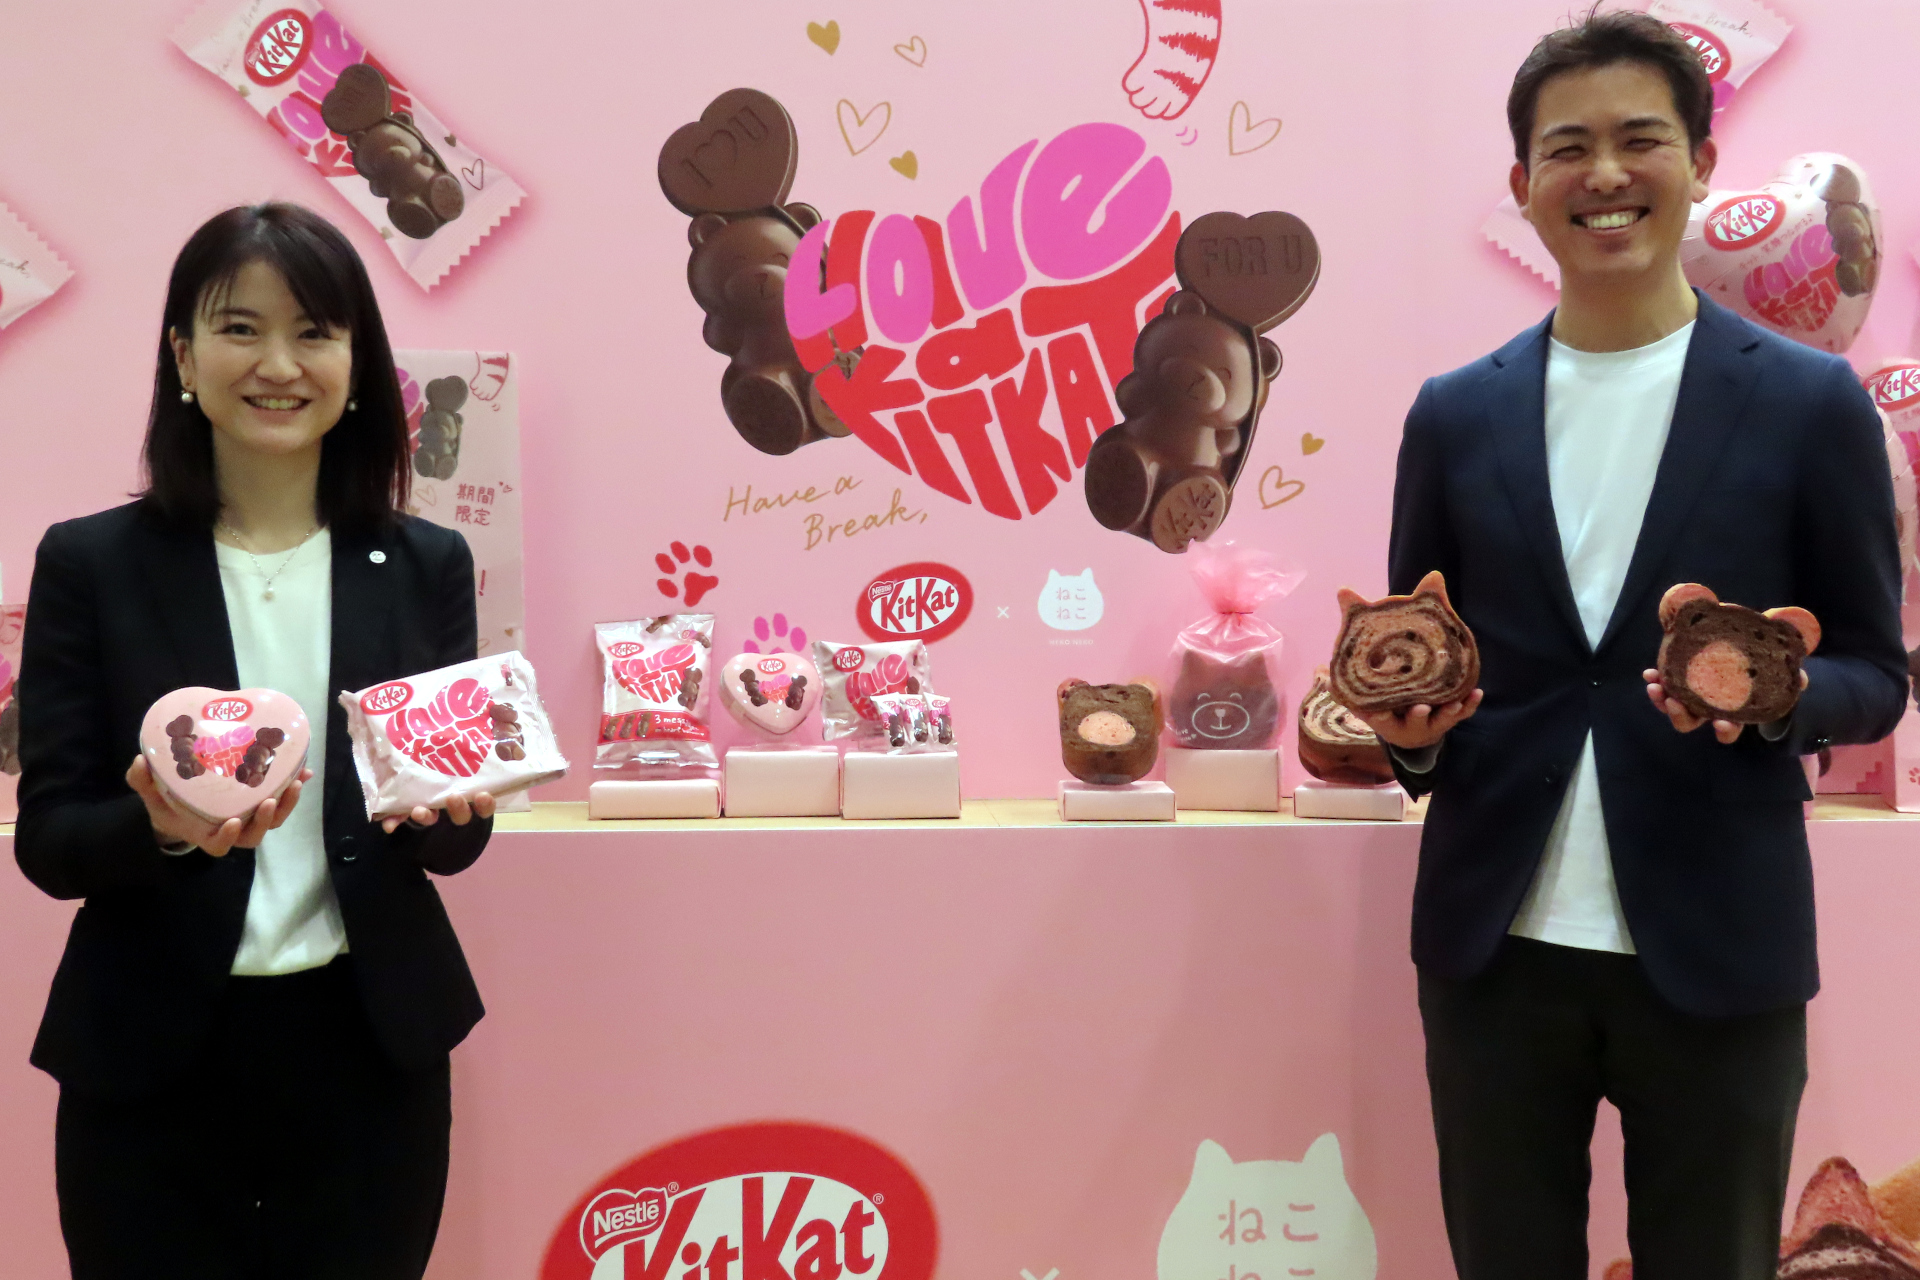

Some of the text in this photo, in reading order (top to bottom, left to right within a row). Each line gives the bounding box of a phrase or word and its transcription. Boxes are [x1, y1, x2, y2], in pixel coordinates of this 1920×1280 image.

[257, 20, 302, 77] KitKat
[1720, 200, 1773, 241] KitKat
[1199, 234, 1302, 277] FOR U
[456, 483, 495, 506] 期間
[724, 475, 864, 522] Have a
[455, 505, 491, 526] 限定
[804, 488, 928, 551] Break,
[880, 578, 955, 633] KitKat
[1056, 587, 1087, 601] ねこ
[1056, 606, 1087, 620] ねこ
[212, 701, 246, 720] KitKat
[370, 686, 406, 710] KitKat
[593, 1199, 660, 1236] Nestlé
[1217, 1200, 1320, 1246] ねこ
